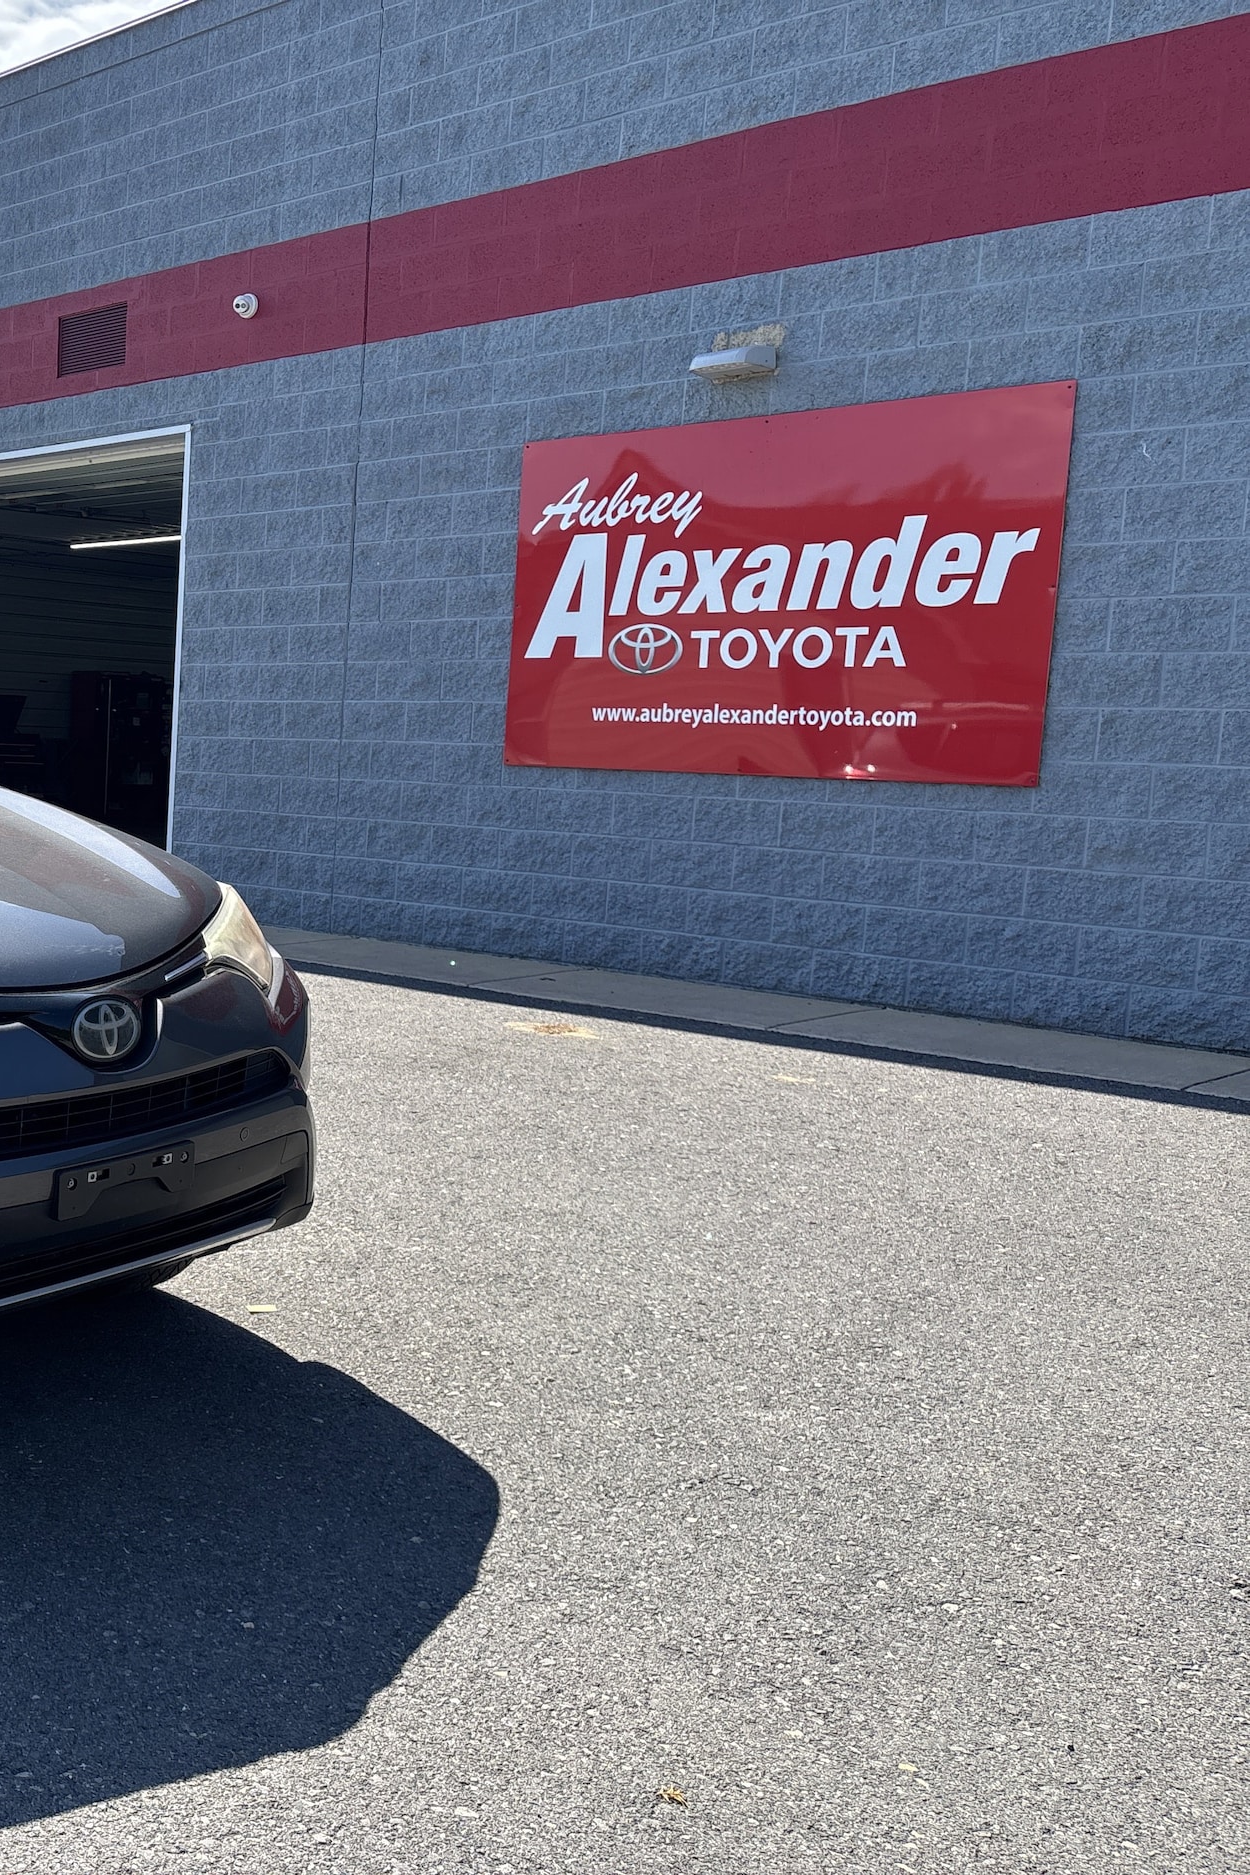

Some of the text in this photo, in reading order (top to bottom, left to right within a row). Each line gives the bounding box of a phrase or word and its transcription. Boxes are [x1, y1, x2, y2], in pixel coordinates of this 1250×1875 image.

[532, 472, 703, 538] Aubrey
[524, 514, 1040, 659] Alexander
[691, 626, 906, 669] TOYOTA
[592, 703, 917, 732] www.aubreyalexandertoyota.com
